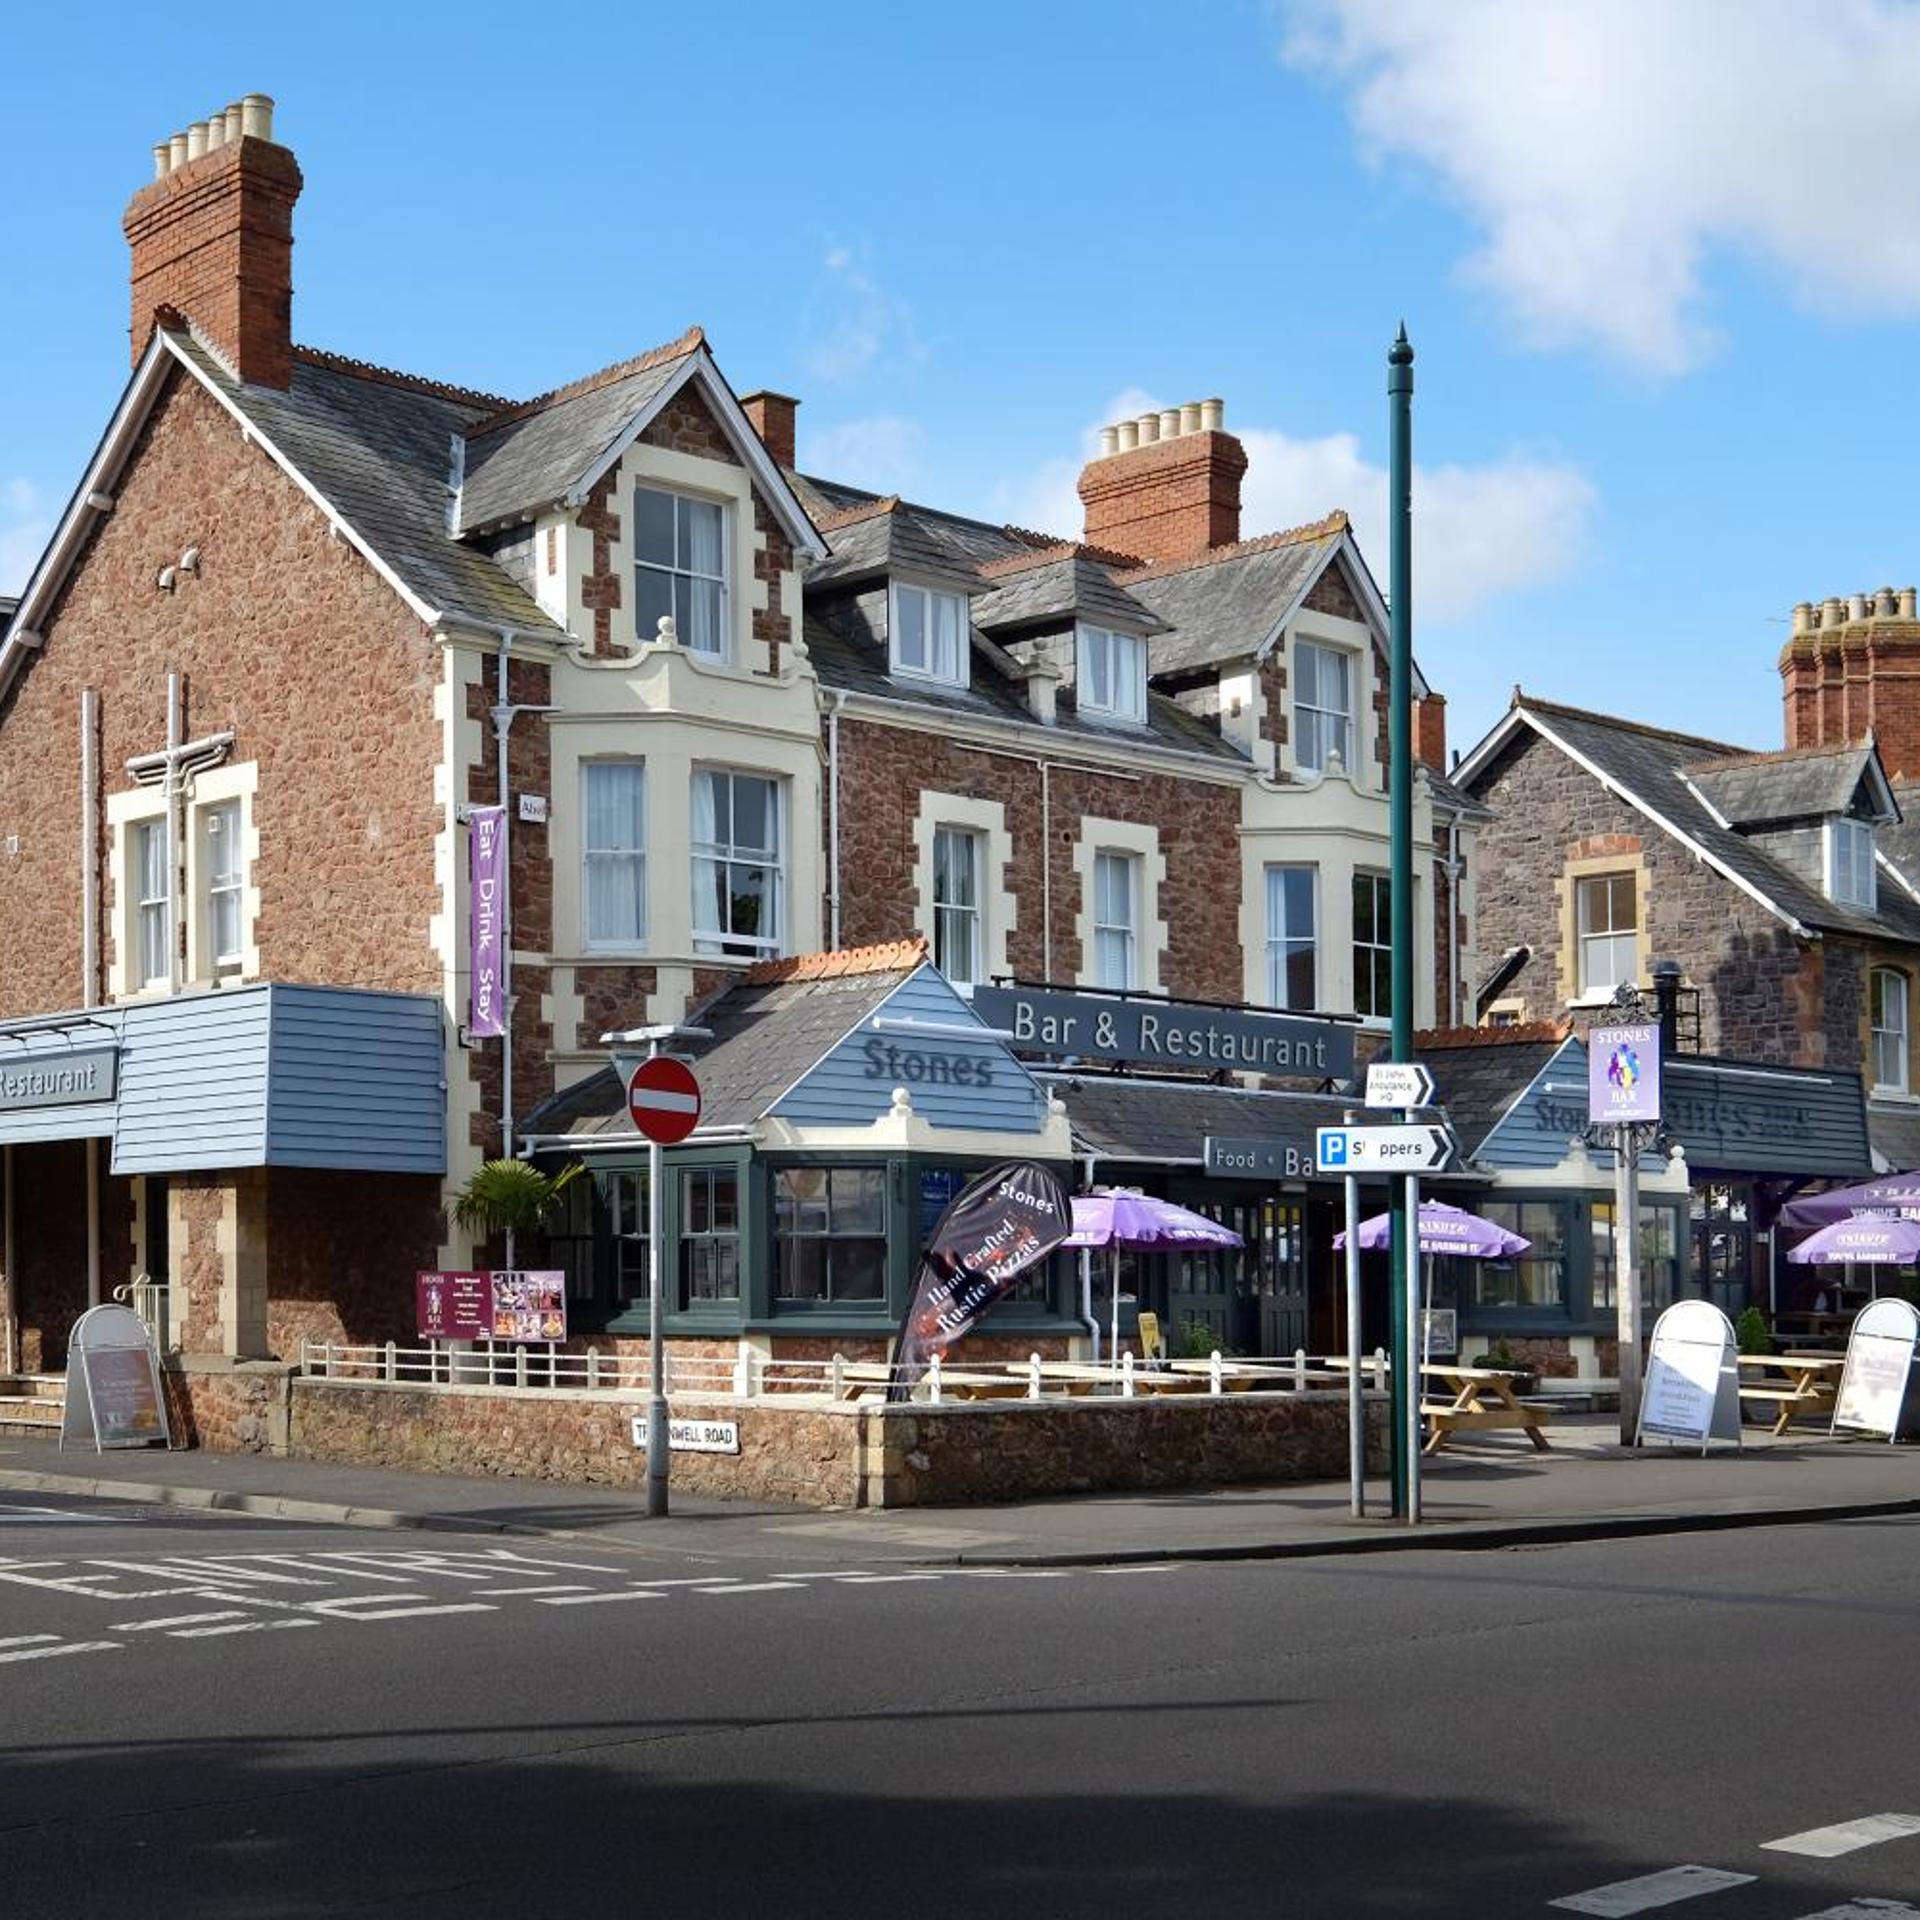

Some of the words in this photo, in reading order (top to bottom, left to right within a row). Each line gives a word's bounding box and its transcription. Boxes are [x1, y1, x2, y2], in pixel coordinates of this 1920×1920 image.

[479, 820, 494, 859] Eat
[479, 879, 494, 950] Drink
[477, 968, 494, 1022] Stay
[1014, 1002, 1077, 1045] Bar
[1095, 1011, 1119, 1049] &
[1139, 1014, 1327, 1069] Restaurant
[1597, 1028, 1651, 1043] STONES
[863, 1038, 993, 1088] Stones
[1216, 1147, 1256, 1169] Food
[1352, 1141, 1423, 1158] Sppers
[999, 1181, 1055, 1214] Stones
[927, 1264, 967, 1306] Hand
[962, 1218, 1015, 1270] Crafted
[935, 1282, 987, 1334] Rustic
[985, 1236, 1040, 1285] Pizzas
[704, 1427, 733, 1444] ROAD
